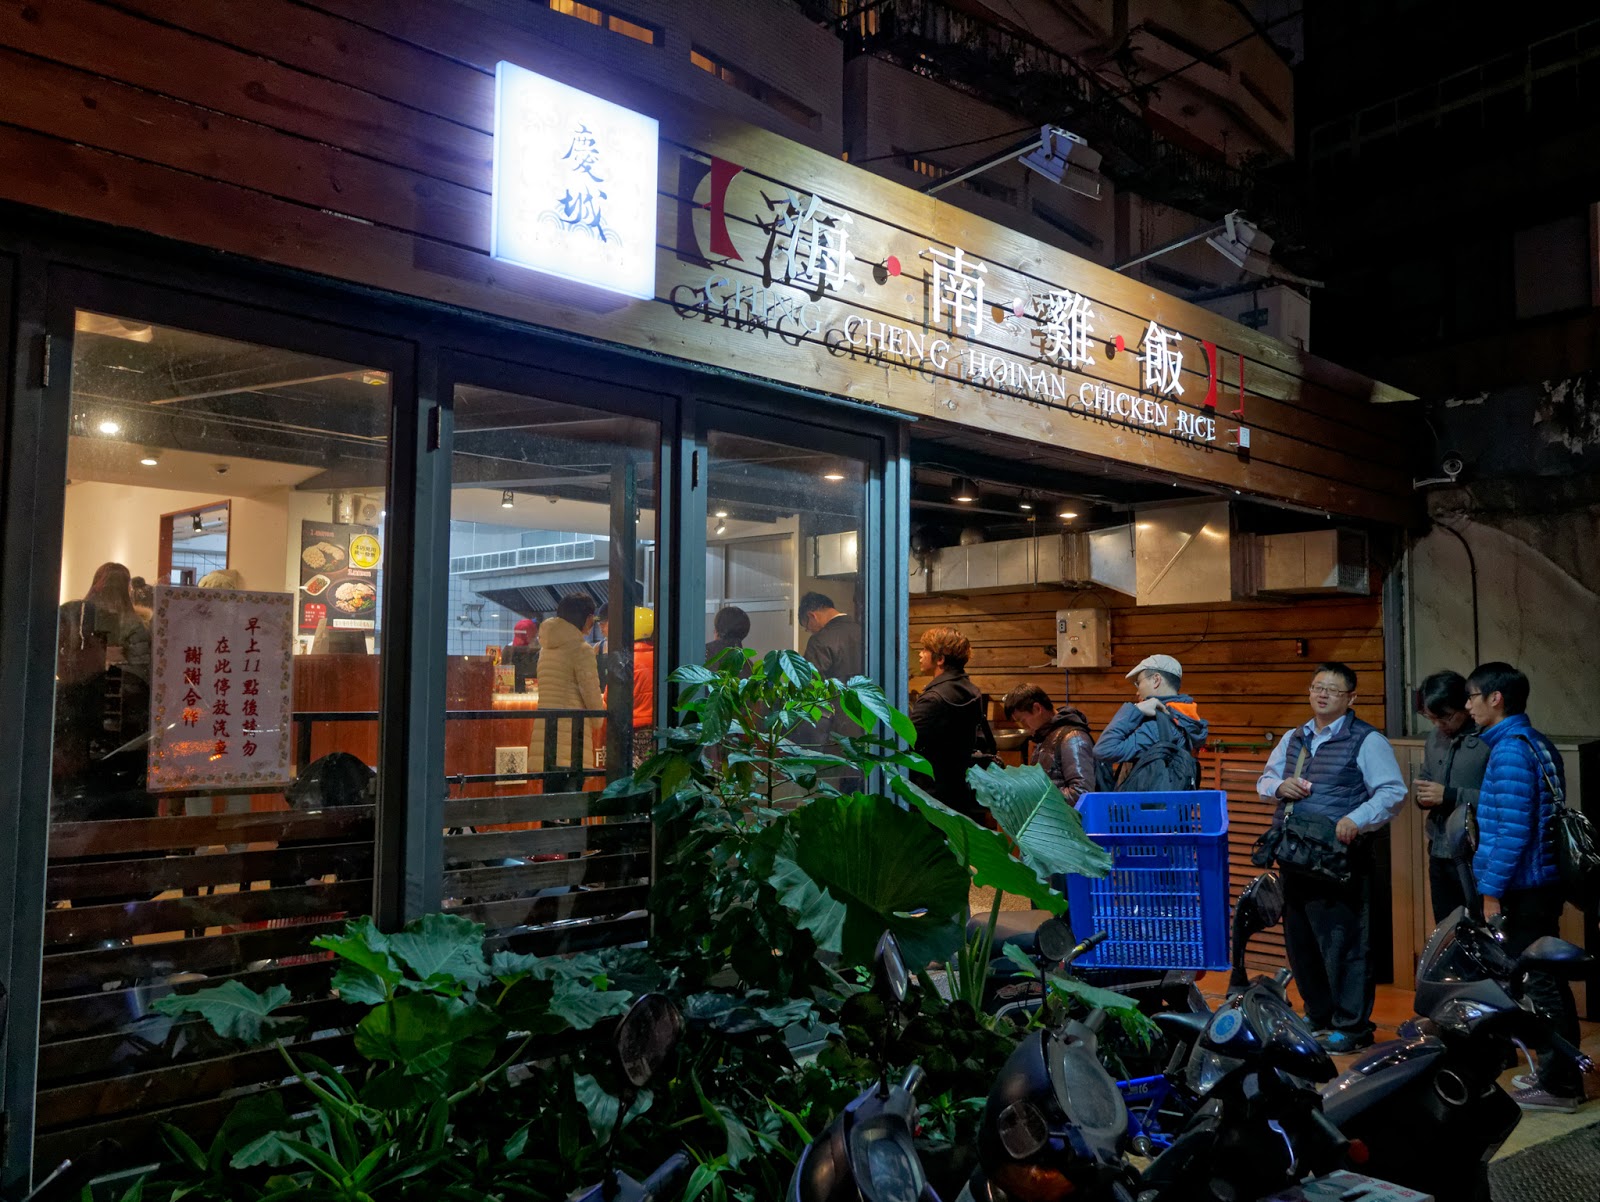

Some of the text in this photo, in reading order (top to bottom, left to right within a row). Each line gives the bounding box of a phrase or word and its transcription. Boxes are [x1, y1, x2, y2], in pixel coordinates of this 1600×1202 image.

[557, 121, 608, 243] 慶城
[705, 274, 822, 334] CHING
[844, 314, 950, 370] CHENG
[968, 349, 1066, 400] HOINAN
[1079, 382, 1168, 427] CHICKEN
[1177, 409, 1217, 441] RICE
[182, 646, 203, 728] 謝謝合作
[212, 636, 232, 756] 在此停放汽車
[242, 617, 261, 757] 早上11點後請勿
